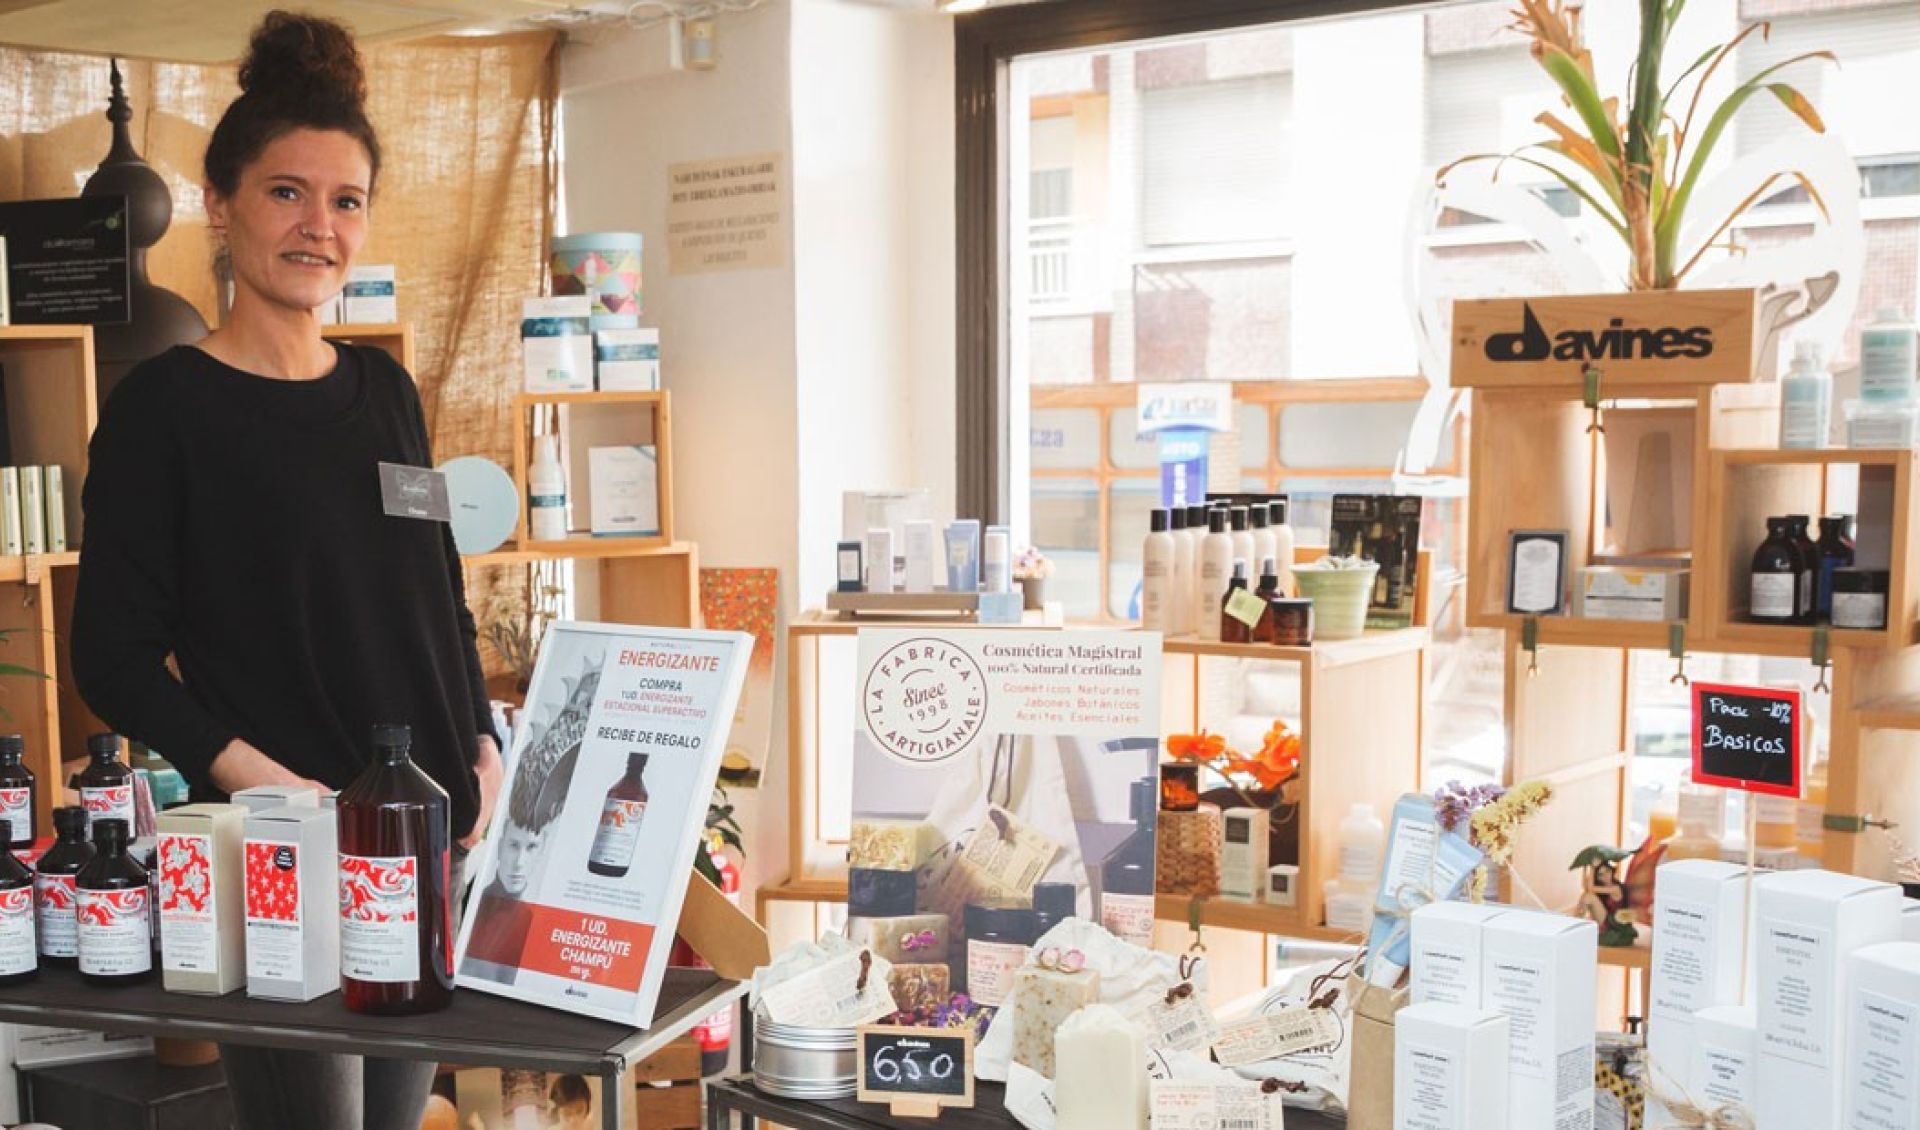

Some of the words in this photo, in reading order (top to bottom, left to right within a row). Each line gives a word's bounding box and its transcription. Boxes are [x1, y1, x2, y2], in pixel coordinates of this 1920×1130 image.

[1484, 302, 1714, 361] davines
[619, 650, 720, 672] ENERGIZANTE
[880, 646, 971, 682] FABRICA
[982, 643, 1064, 660] Cosmética
[1068, 644, 1143, 662] Magistral
[1023, 663, 1069, 676] Natural
[1072, 664, 1143, 677] Certificada
[640, 678, 683, 692] COMPRA
[1078, 684, 1141, 696] Naturales
[908, 699, 949, 722] 1998
[598, 725, 636, 745] RECIBE
[637, 729, 653, 746] DE
[654, 731, 702, 750] REGALO
[885, 697, 981, 756] ARTIGIANALE
[550, 927, 632, 957] ENERGIZANTE
